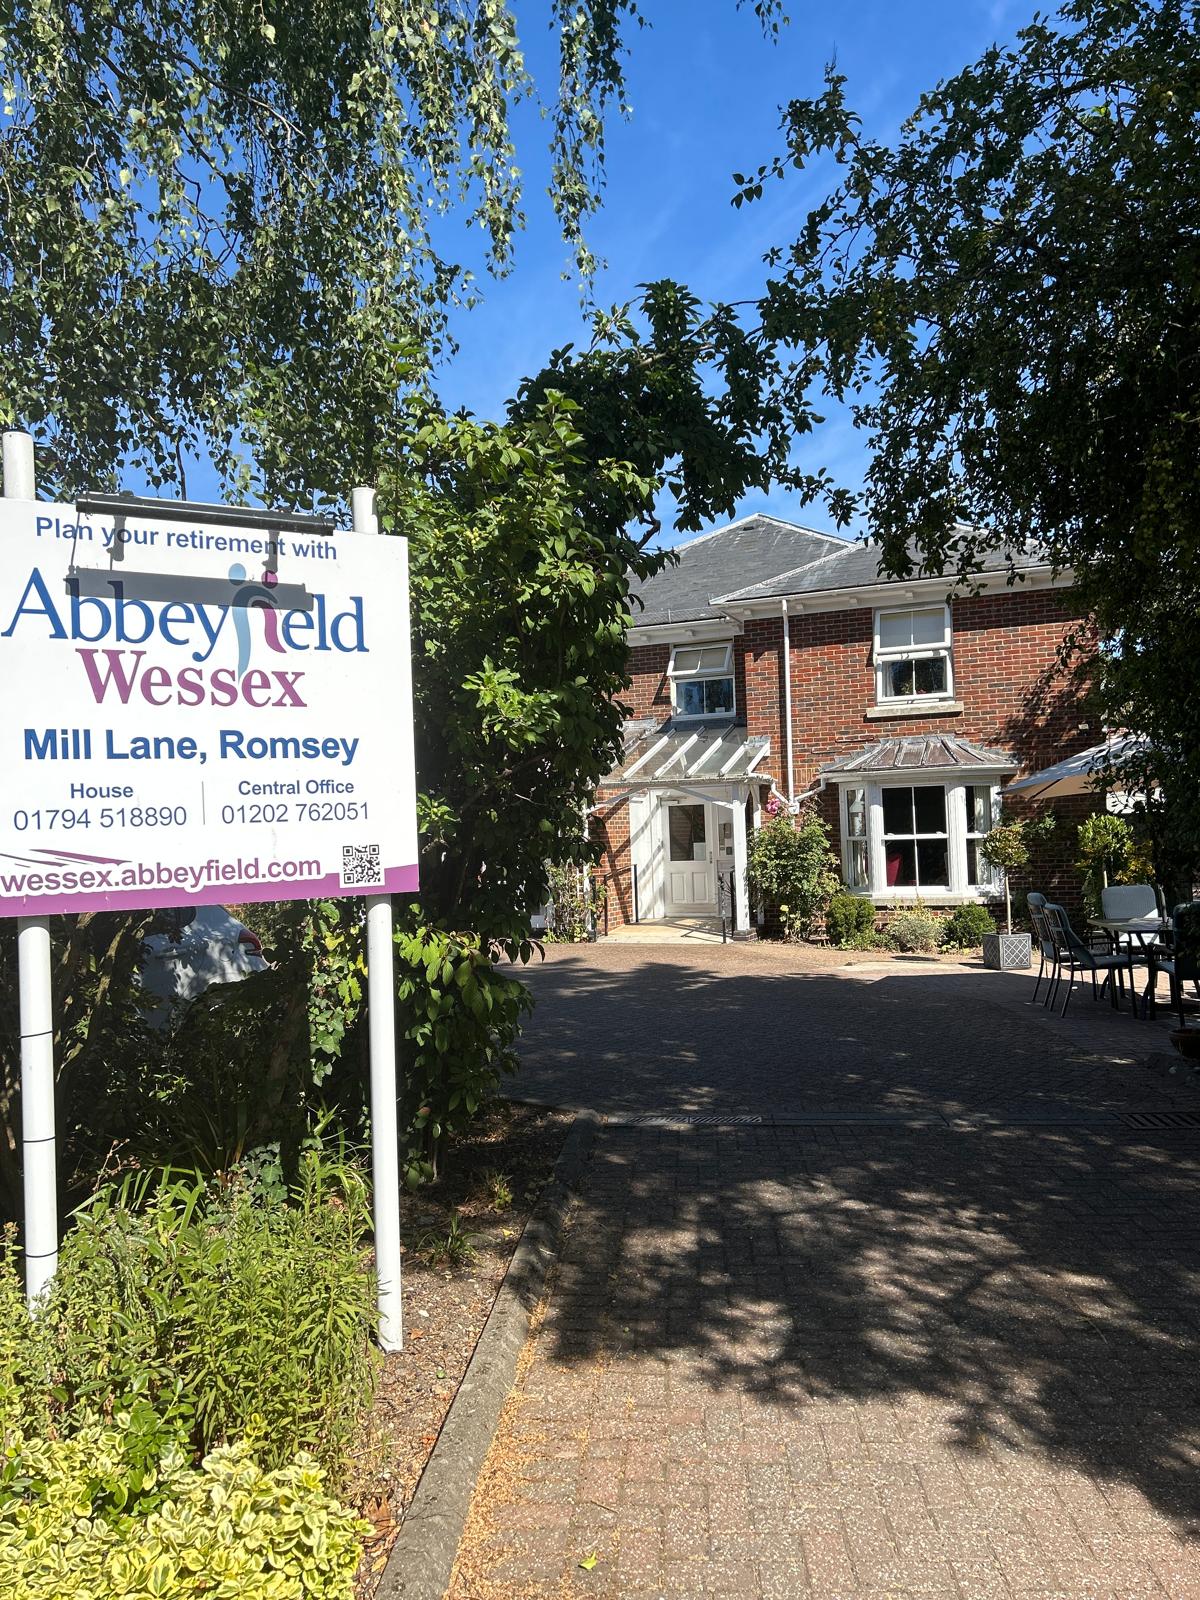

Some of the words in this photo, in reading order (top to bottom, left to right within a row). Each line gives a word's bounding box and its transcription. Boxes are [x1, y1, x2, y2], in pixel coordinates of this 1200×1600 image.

[36, 516, 93, 541] Plan
[101, 526, 159, 547] your
[167, 529, 286, 556] retirement
[292, 539, 337, 560] with
[1, 563, 370, 684] Abbeyfield
[75, 647, 308, 708] Wessex
[24, 728, 92, 761] Mill
[106, 729, 207, 764] Lane,
[219, 729, 360, 766] Romsey
[70, 783, 134, 799] House
[238, 780, 300, 796] Central
[305, 779, 355, 795] Office
[13, 809, 92, 831] 01794
[99, 806, 188, 829] 518890
[221, 803, 289, 825] 01202
[295, 801, 369, 822] 762051
[0, 857, 322, 893] wessex.abbeyfield.com
